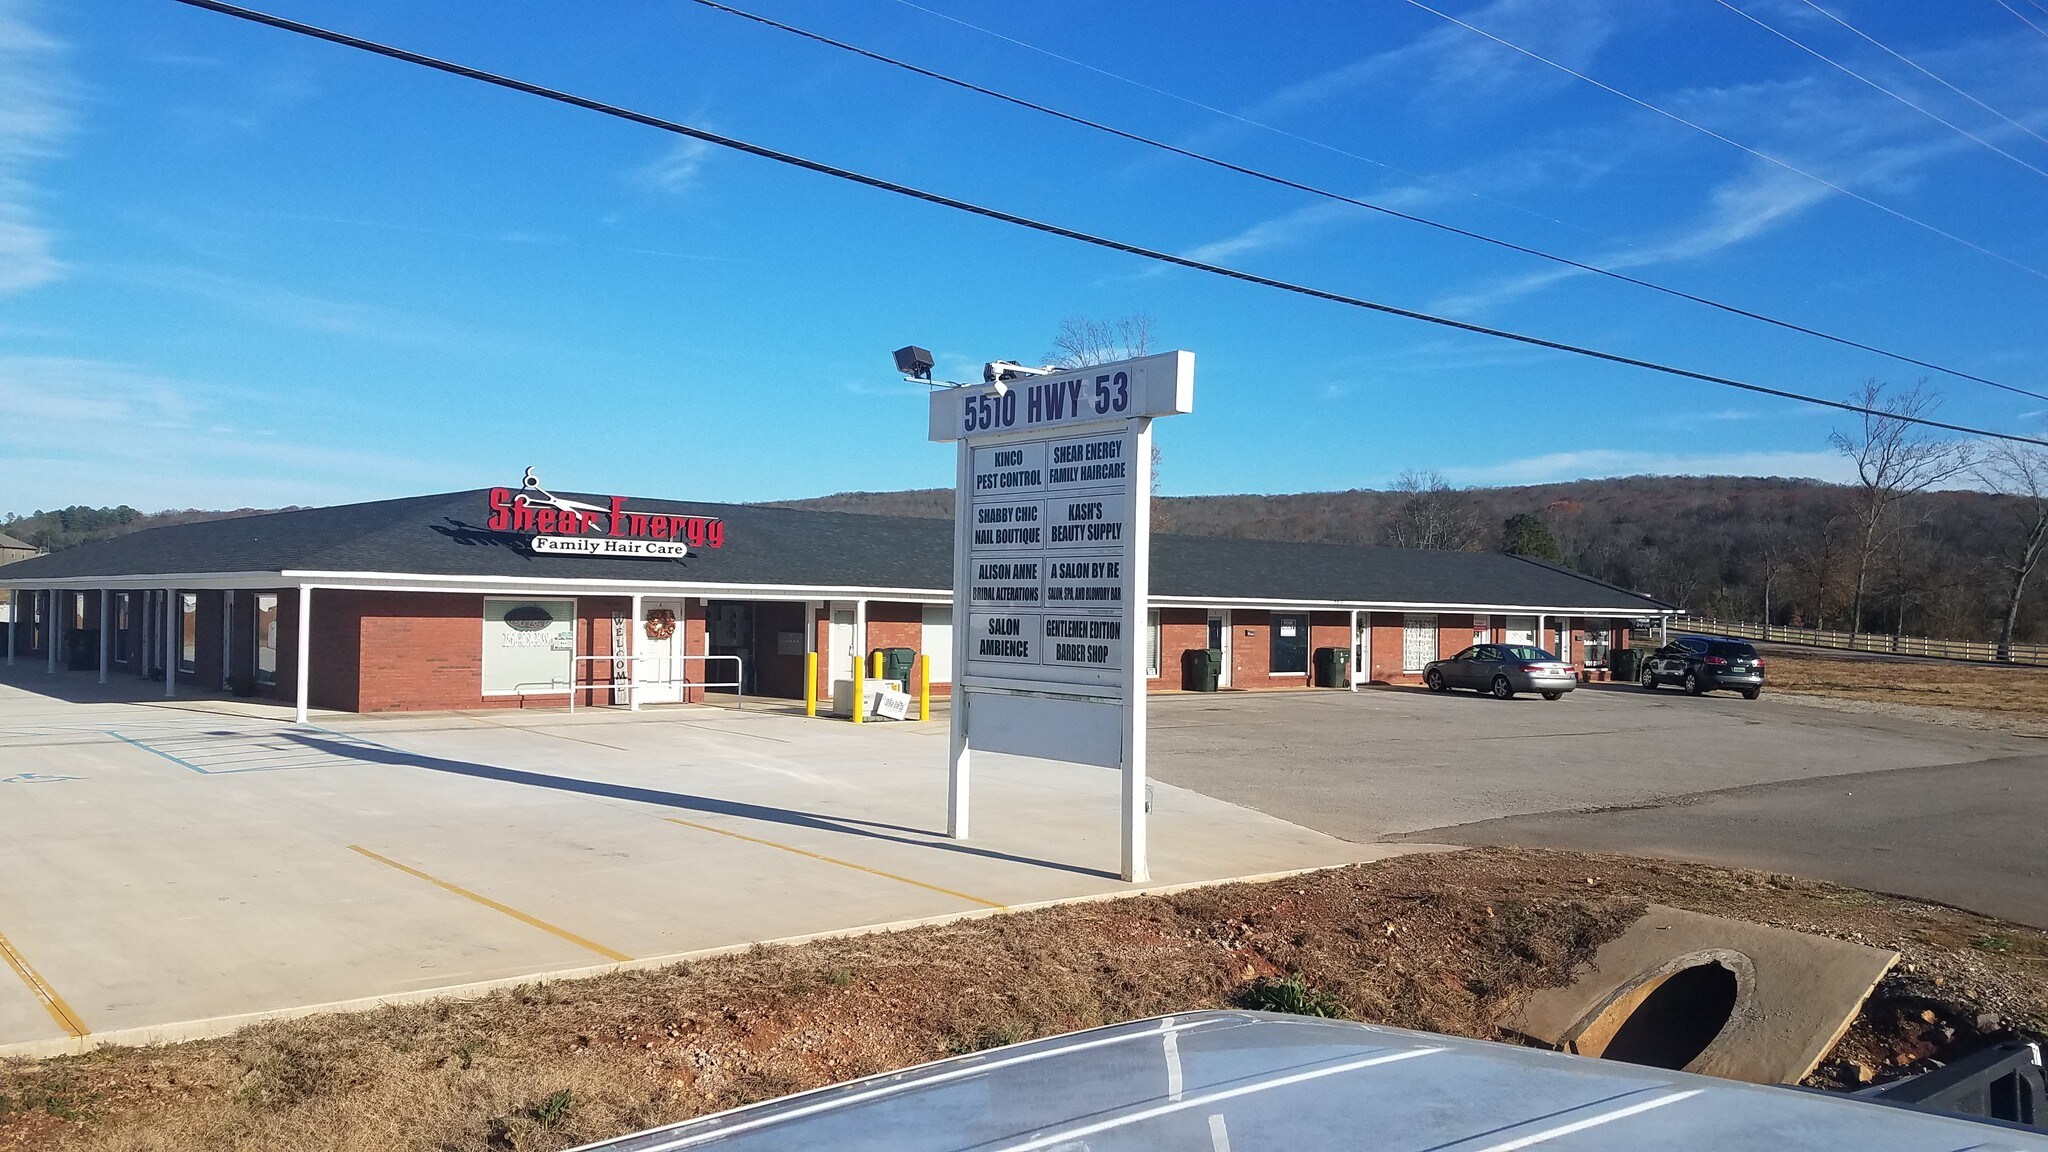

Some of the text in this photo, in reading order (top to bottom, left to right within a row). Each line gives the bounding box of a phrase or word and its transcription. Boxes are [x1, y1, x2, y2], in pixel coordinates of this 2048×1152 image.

[964, 371, 1128, 432] 5510 HWY 53
[994, 450, 1023, 468] KINCO
[1053, 440, 1122, 464] SHEAR ENERGY
[977, 470, 1042, 490] PEST CONTROL
[1049, 462, 1126, 484] FAMILY HAIRCARE
[488, 487, 723, 549] Shear Energy
[978, 505, 1038, 524] SHABBY CHIC
[1068, 502, 1103, 521] KASH'S
[975, 527, 1040, 545] NAIL BOUTIQUE
[1051, 522, 1122, 542] BEAUTY SUPPLY
[536, 538, 683, 555] Family Hair Care
[978, 563, 1038, 580] ALISON ANNE
[1051, 561, 1120, 579] A SALON BY RE
[972, 586, 1039, 601] BRIDAL ALTERATIONS
[1075, 586, 1085, 600] AND
[1086, 586, 1110, 600] BLOWDRY
[1110, 586, 1121, 600] BAR
[988, 618, 1020, 636] SALON
[1046, 619, 1121, 640] GENTLEMEN EDITION
[614, 617, 626, 692] WELCOME
[979, 639, 1029, 658] AMBIENCE
[1056, 643, 1109, 664] BARBER SHOP
